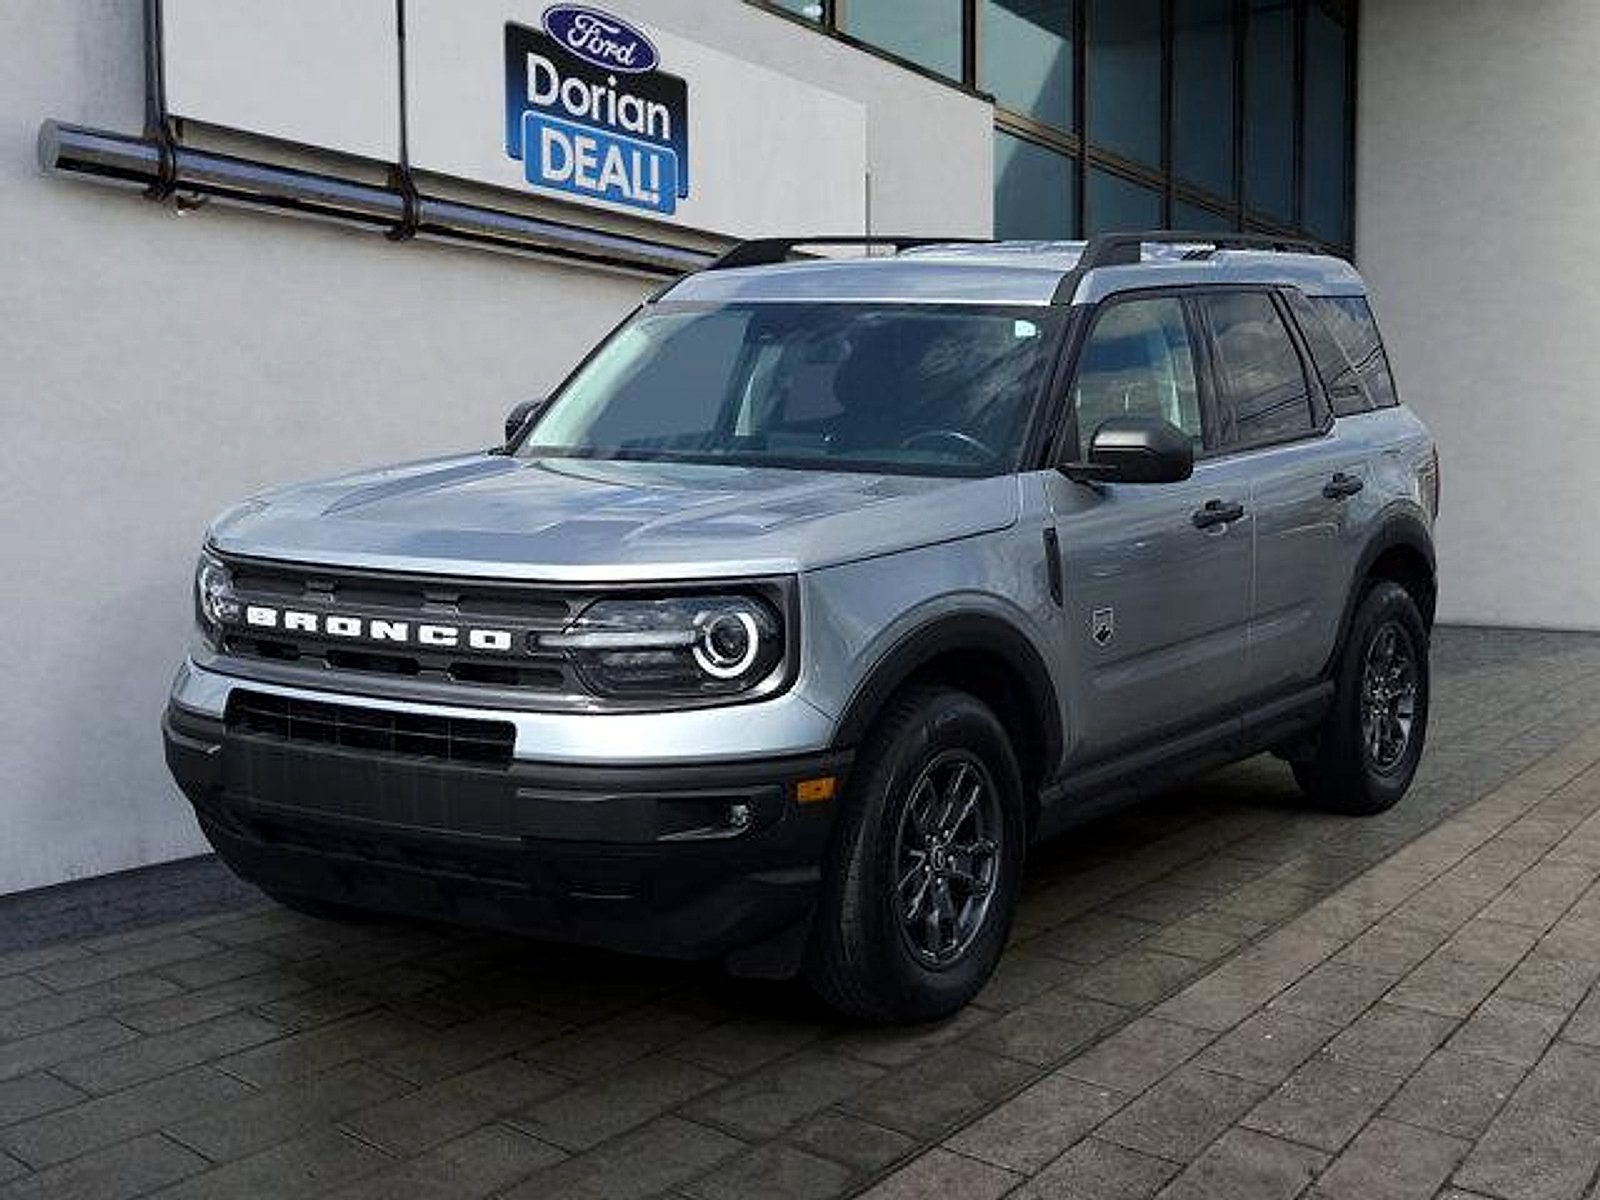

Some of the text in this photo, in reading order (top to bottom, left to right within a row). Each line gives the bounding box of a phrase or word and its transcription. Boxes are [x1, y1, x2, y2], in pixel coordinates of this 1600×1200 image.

[567, 14, 637, 65] Ford
[527, 52, 671, 140] Dorian
[542, 127, 660, 204] DEAL!
[246, 605, 512, 650] BRONCO
